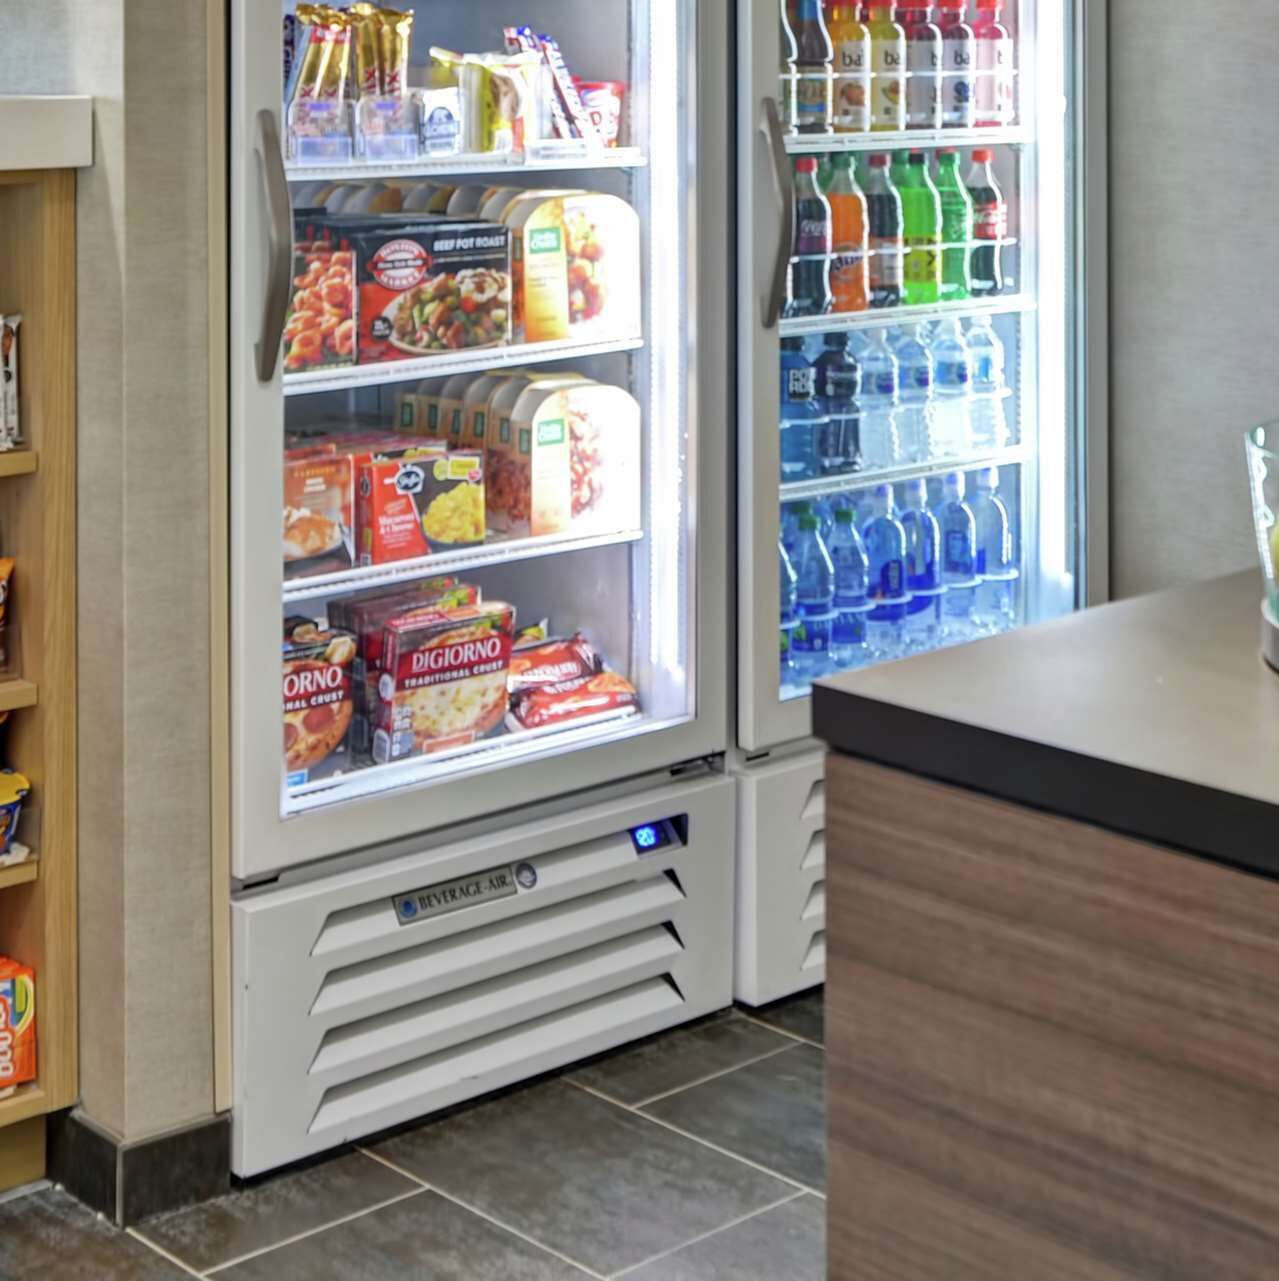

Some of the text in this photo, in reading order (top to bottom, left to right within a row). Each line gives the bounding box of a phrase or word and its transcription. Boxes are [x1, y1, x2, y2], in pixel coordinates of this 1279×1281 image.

[433, 235, 506, 252] BEEF POT ROAST
[411, 638, 502, 672] DIGIORNO
[283, 666, 343, 696] ORNO
[404, 669, 472, 688] TRADITIONAL
[473, 660, 505, 676] CRUST
[309, 690, 344, 709] CRUST
[419, 875, 510, 911] BEVERAGE-AIR
